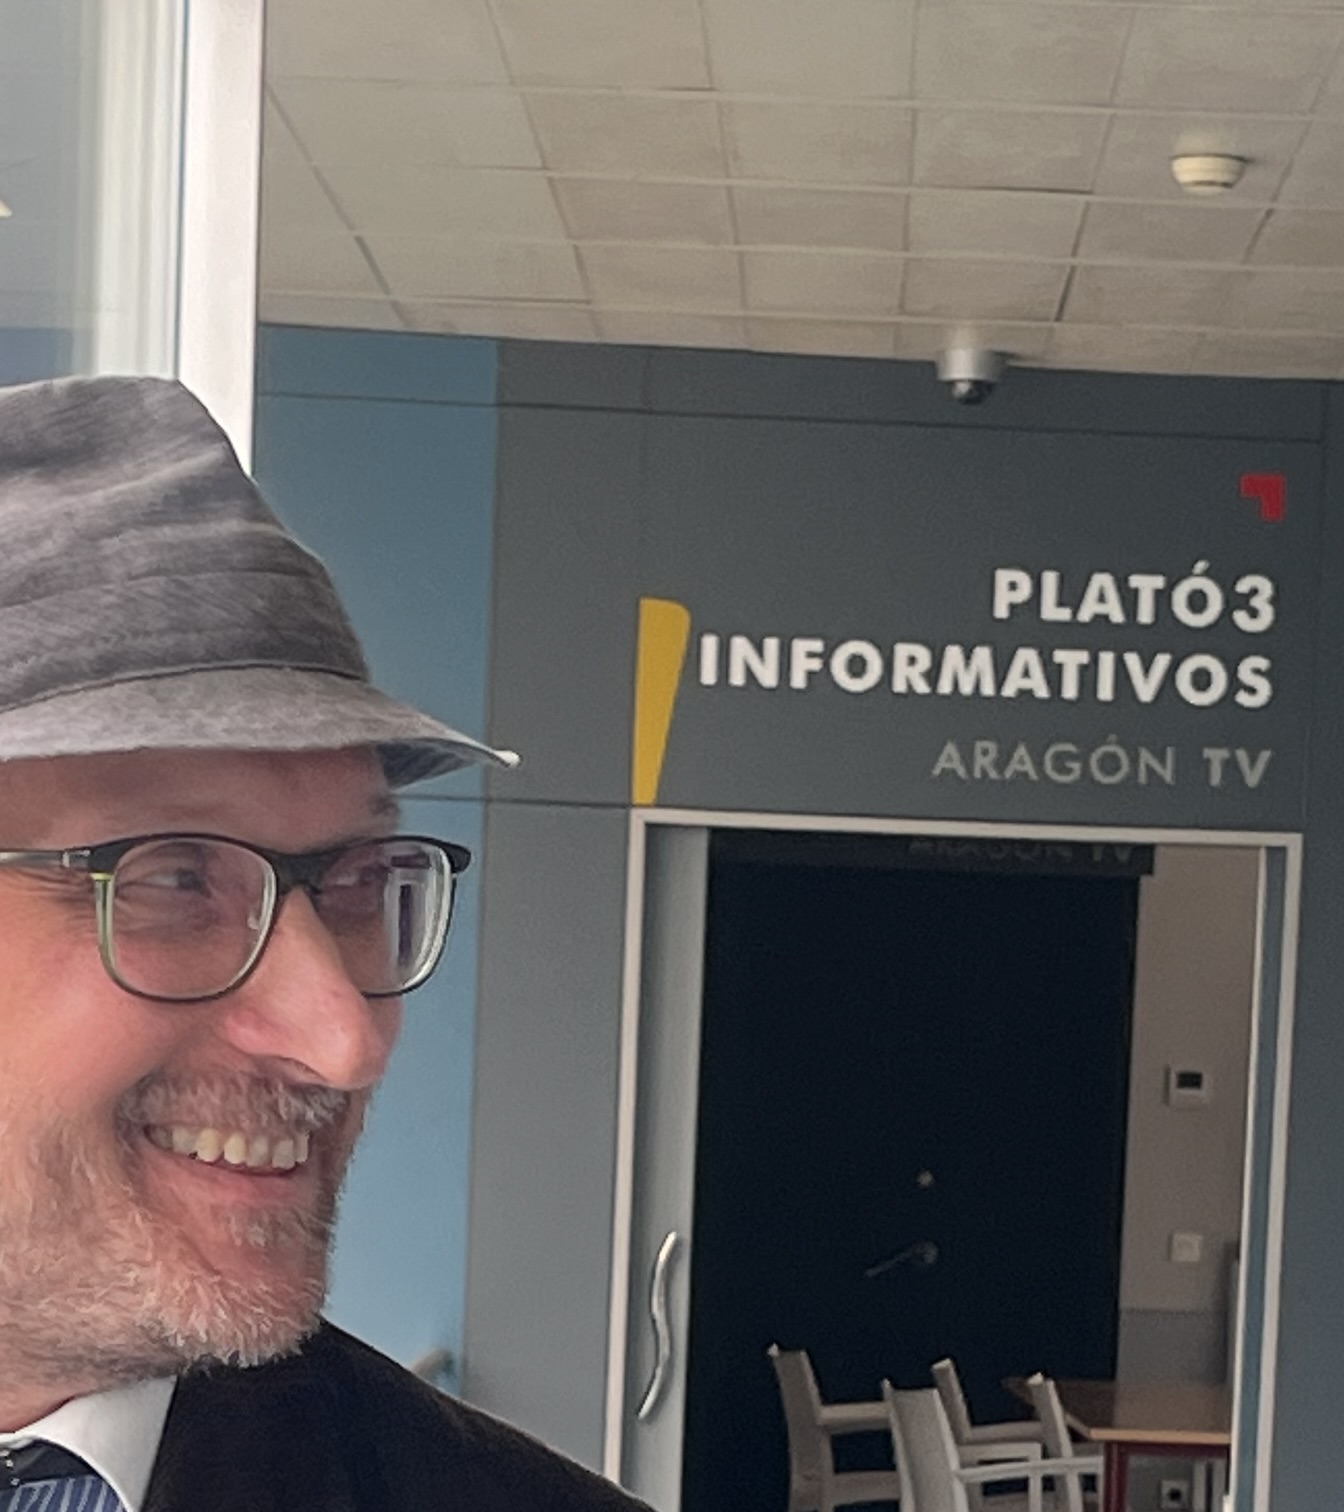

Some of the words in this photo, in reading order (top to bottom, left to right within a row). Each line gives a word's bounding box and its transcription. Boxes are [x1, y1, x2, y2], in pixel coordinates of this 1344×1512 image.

[699, 634, 1273, 708] INFORMATIVOS
[931, 734, 1176, 785] ARAGÓN
[1202, 747, 1272, 788] TV
